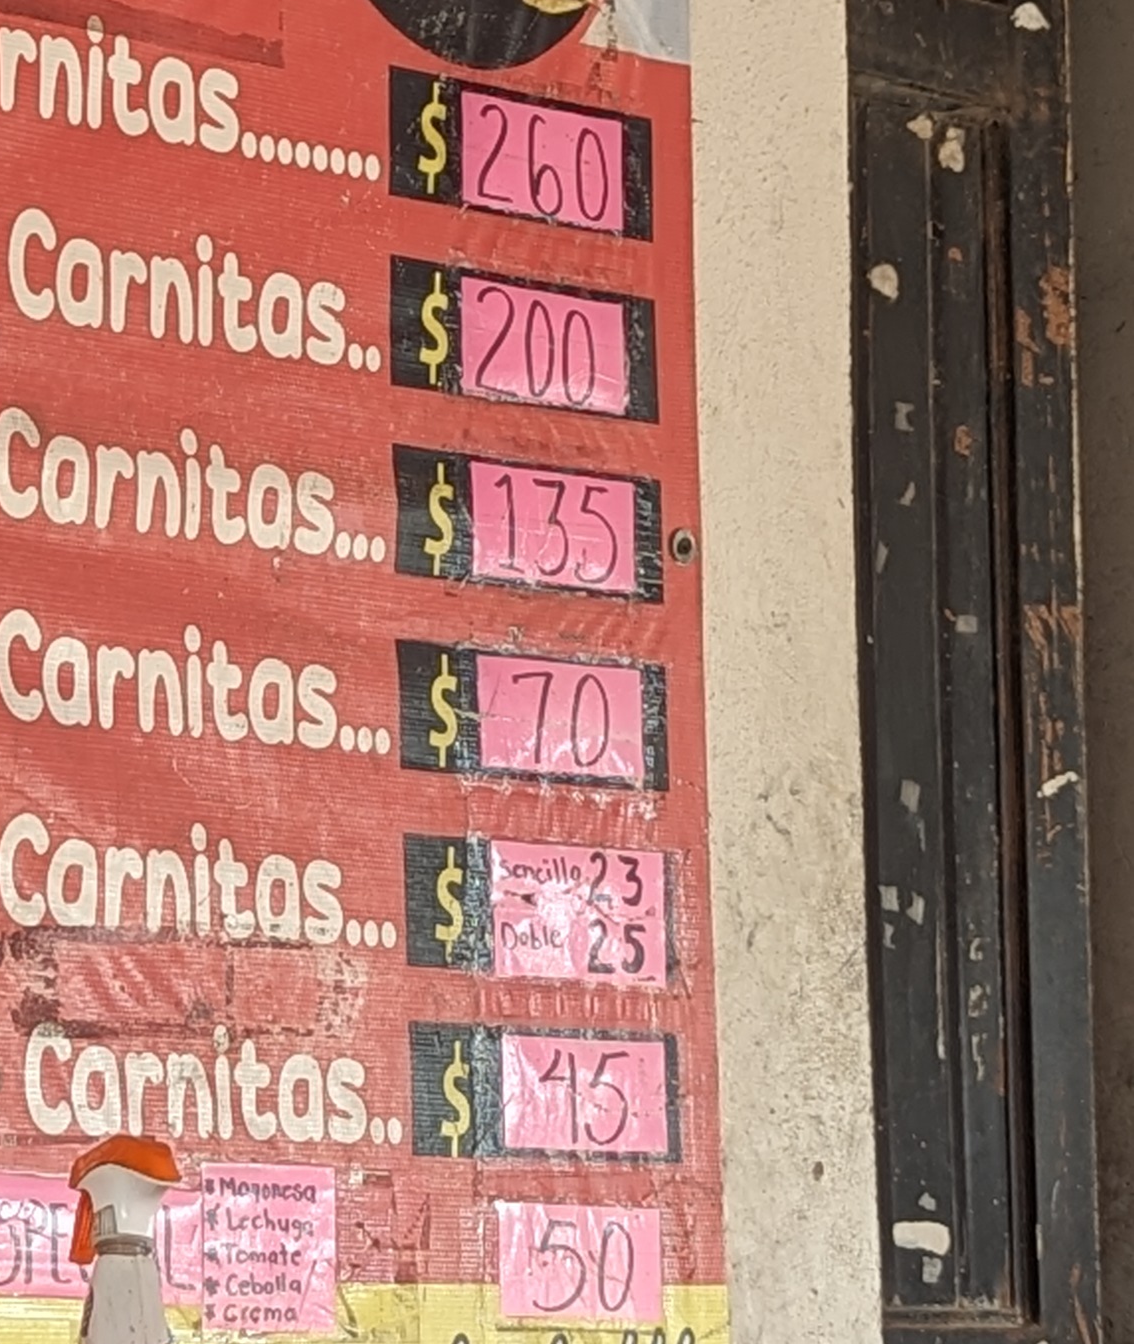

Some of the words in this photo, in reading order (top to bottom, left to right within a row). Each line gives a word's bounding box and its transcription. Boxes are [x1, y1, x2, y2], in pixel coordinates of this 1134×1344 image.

[417, 82, 448, 195] $
[477, 104, 609, 222] 260
[419, 272, 450, 385] $
[476, 285, 596, 406] 200
[423, 462, 454, 576] $
[493, 473, 619, 585] 135
[429, 654, 459, 768] $
[512, 671, 610, 768] 70
[435, 846, 465, 964] $
[588, 851, 645, 908] 23
[501, 921, 566, 951] Doble
[587, 919, 647, 976] 25
[440, 1040, 472, 1158] $
[538, 1048, 630, 1146] 45
[220, 1243, 302, 1266] Tomate
[225, 1272, 302, 1297] Cebolla
[532, 1219, 635, 1313] 50
